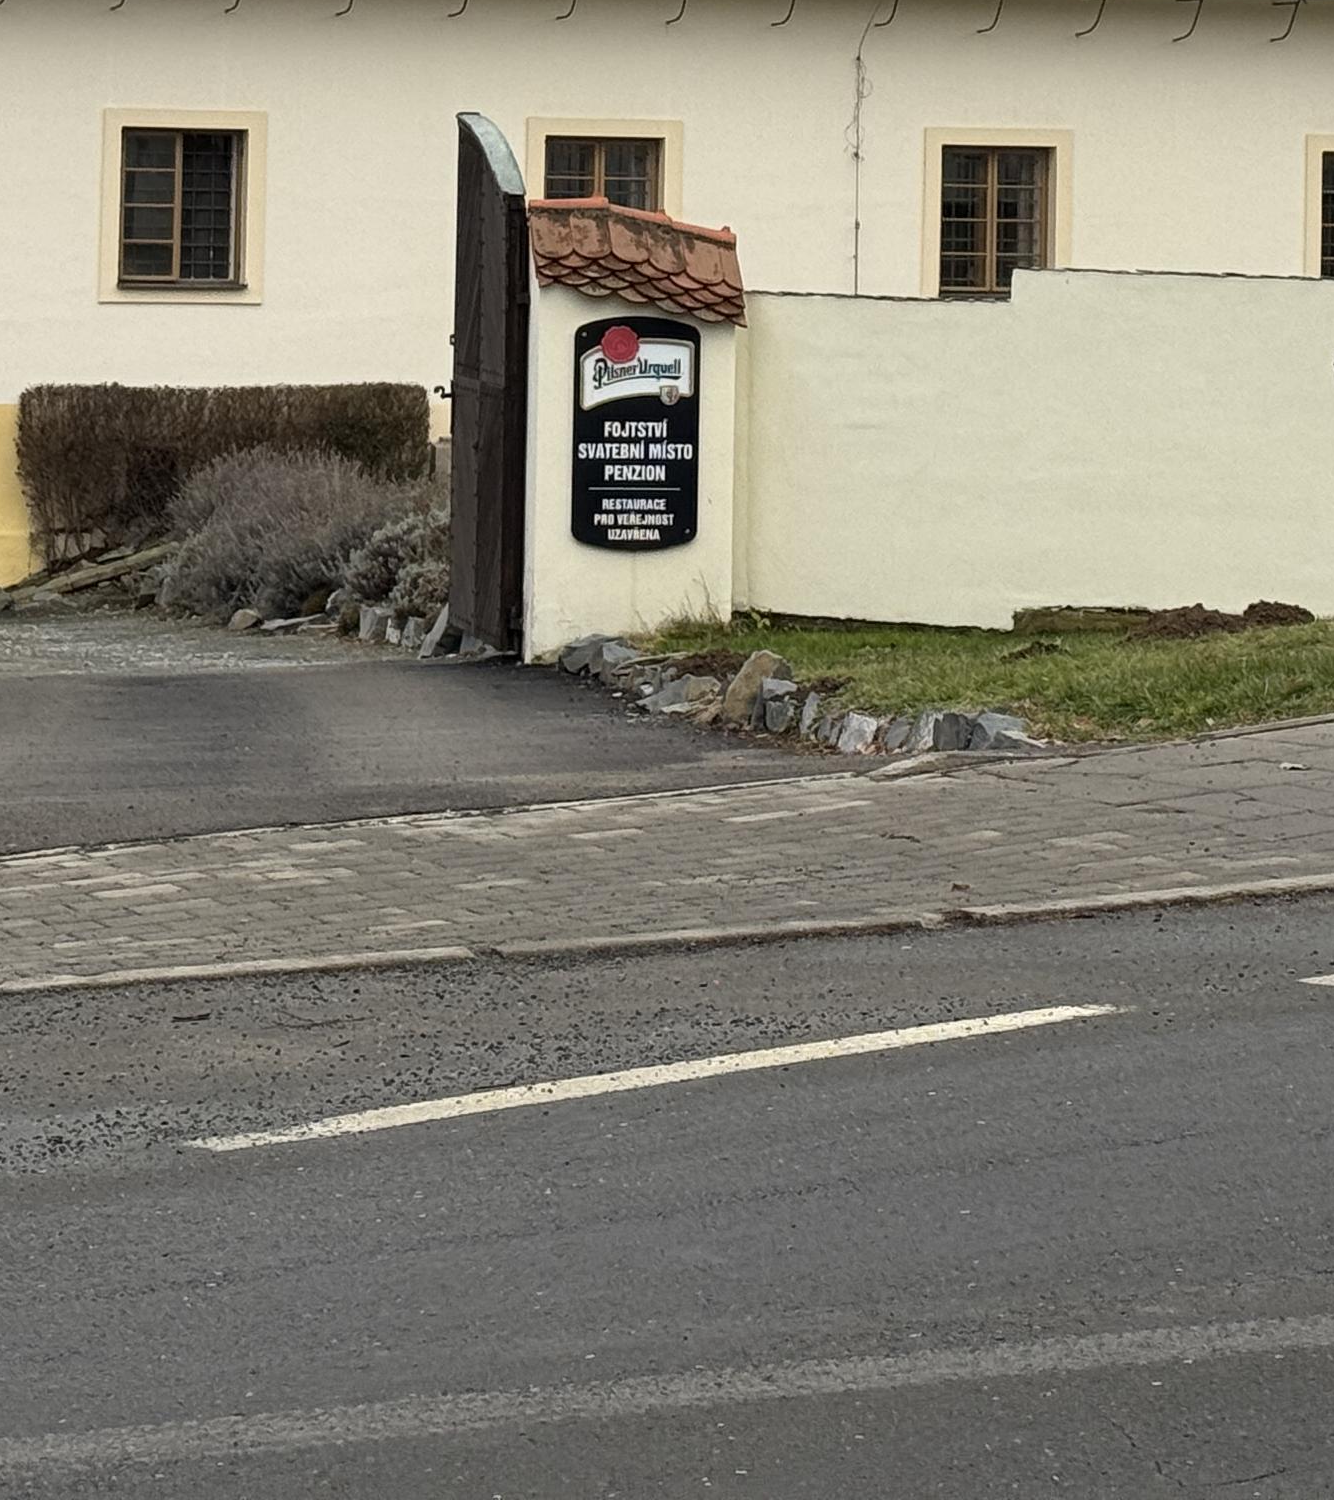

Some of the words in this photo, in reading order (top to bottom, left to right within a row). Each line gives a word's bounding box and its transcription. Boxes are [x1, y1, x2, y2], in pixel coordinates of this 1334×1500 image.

[593, 358, 638, 390] Pilsner
[637, 357, 681, 381] Urquell
[603, 418, 668, 438] FOJTSTVÍ
[577, 440, 645, 461] SVATEBNÍ
[648, 439, 694, 460] MÍSTO
[604, 464, 666, 482] PENZION
[602, 498, 667, 511] RESTAURACE
[594, 513, 615, 526] PRO
[617, 511, 675, 526] VEŘEJNOST
[608, 527, 661, 541] UZAVŘENA
